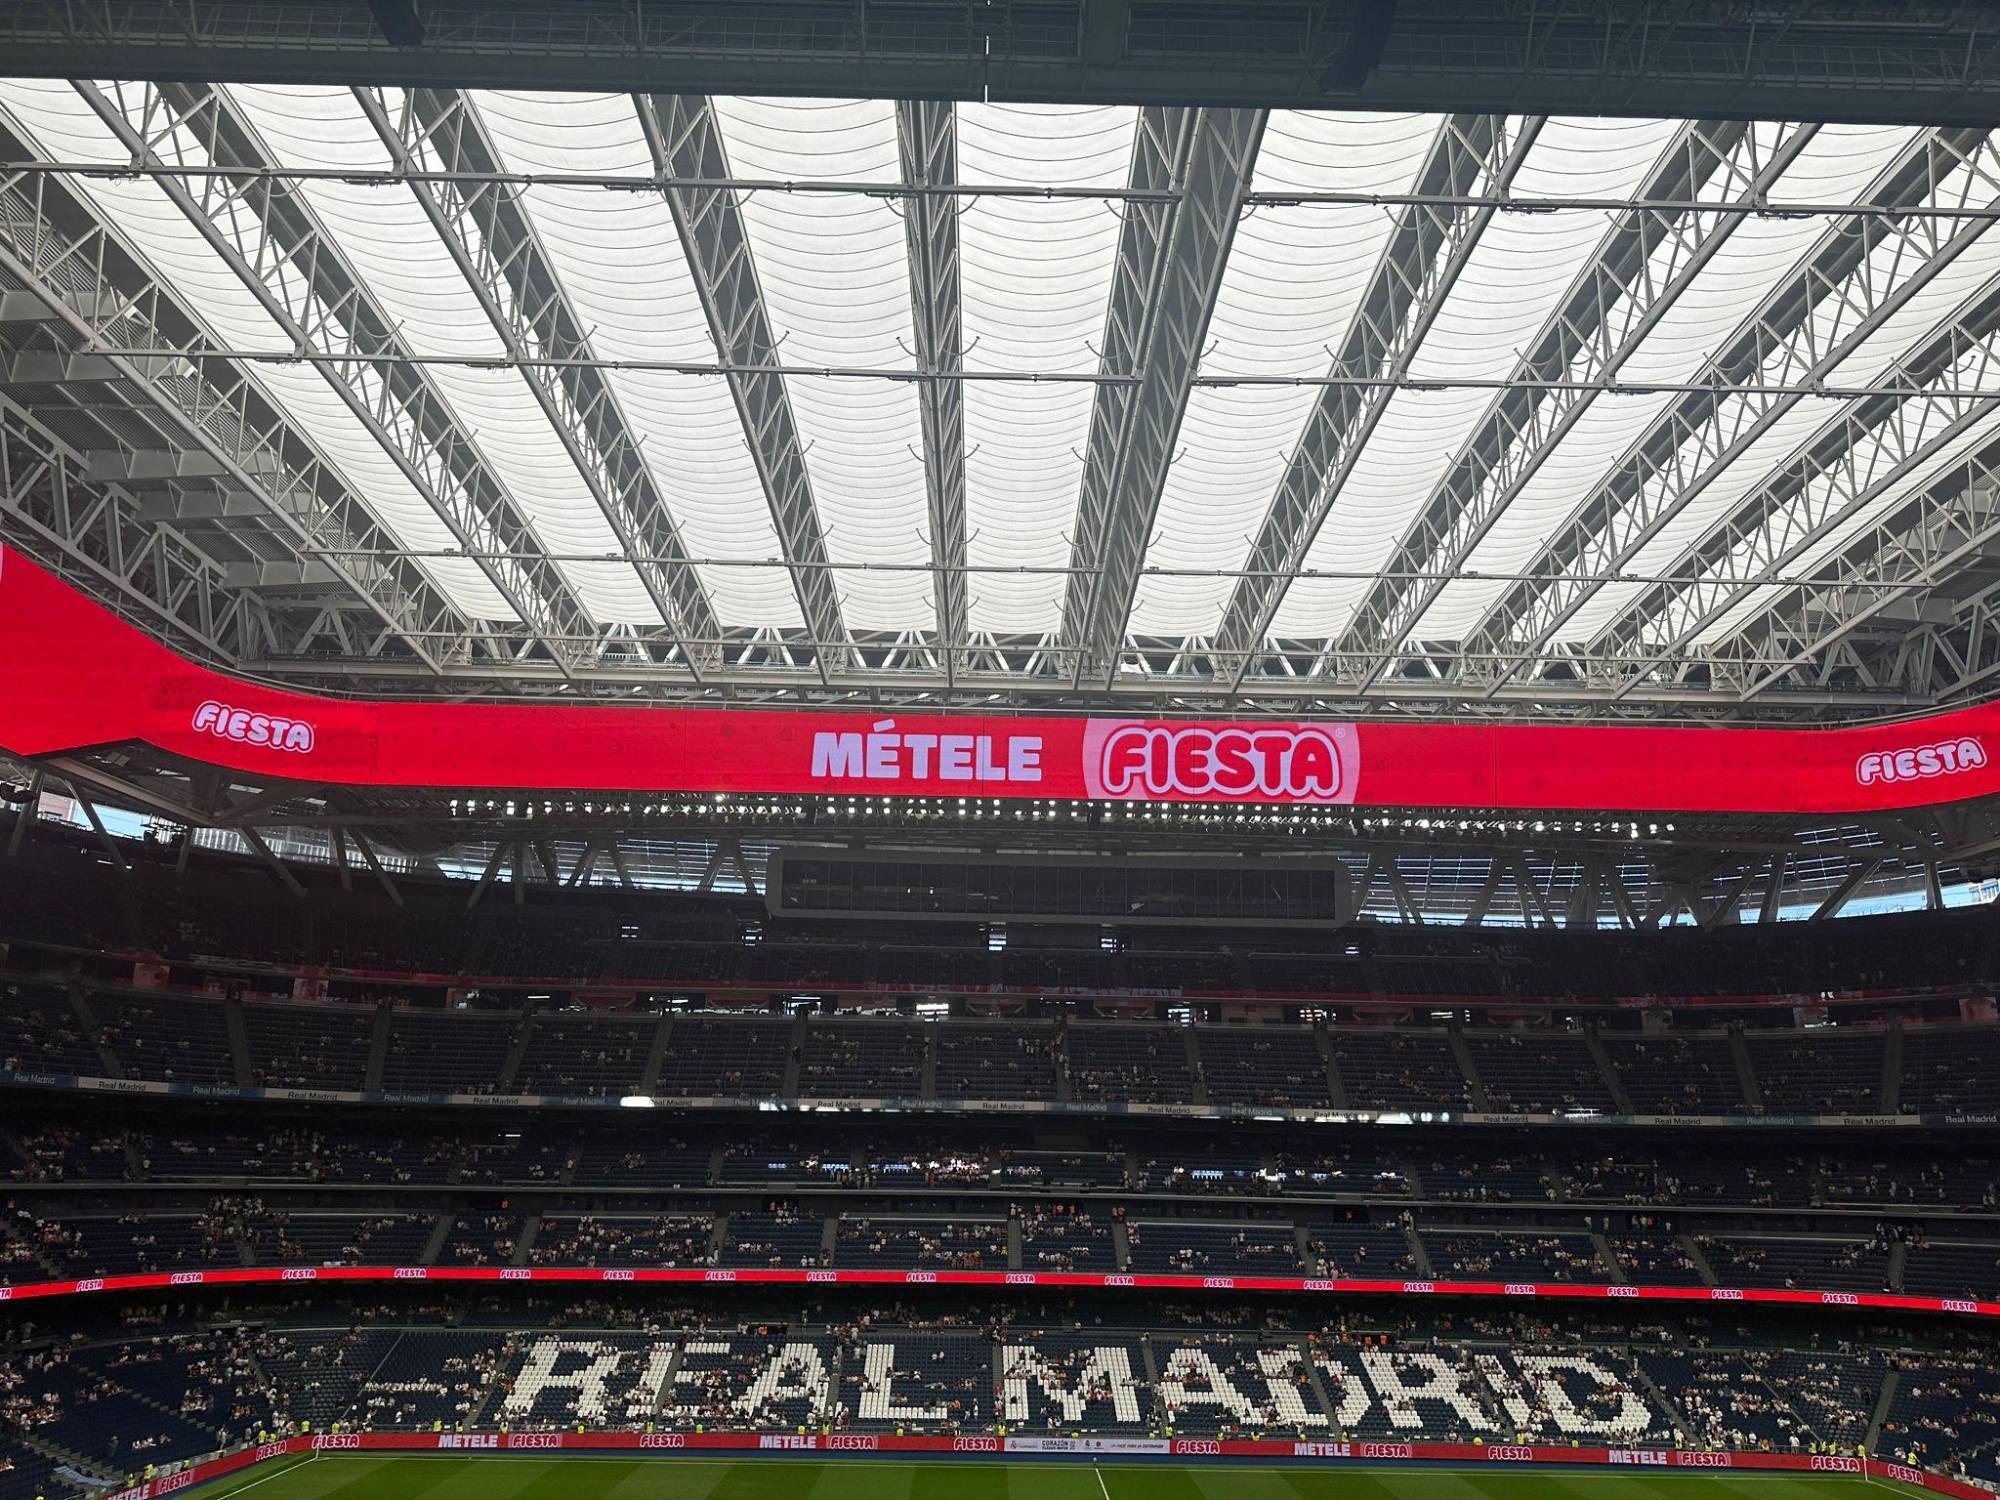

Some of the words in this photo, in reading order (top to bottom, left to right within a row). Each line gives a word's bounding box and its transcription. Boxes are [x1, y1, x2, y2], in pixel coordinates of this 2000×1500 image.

[193, 701, 314, 753] FIESTA
[811, 719, 1042, 781] MÉTELE
[1103, 727, 1341, 797] FIESTA
[1857, 738, 1987, 785] FIESTA
[14, 1073, 30, 1082] Real
[30, 1074, 55, 1084] Madrid
[99, 1081, 116, 1089] Real
[118, 1082, 146, 1091] Madrid
[193, 1086, 210, 1095] Real
[212, 1087, 240, 1095] Madrid
[384, 1094, 401, 1102] Real
[403, 1095, 429, 1103] Madrid
[1866, 1118, 1896, 1126] Madrid
[1945, 1115, 1965, 1124] Real
[1967, 1115, 1997, 1124] Madrid
[171, 1272, 203, 1284] FIESTA
[282, 1269, 316, 1280] FIESTA
[394, 1268, 427, 1279] FIESTA
[499, 1269, 531, 1279] FIESTA
[603, 1270, 634, 1280] FIESTA
[705, 1271, 736, 1281] FIESTA
[806, 1272, 836, 1281] FIESTA
[906, 1273, 936, 1282] FIESTA
[1006, 1274, 1035, 1284] FIESTA
[76, 1279, 103, 1292] FIESTA
[1104, 1276, 1134, 1286] FIESTA
[1203, 1278, 1234, 1288] FIESTA
[1303, 1280, 1334, 1290] FIESTA
[1404, 1282, 1434, 1293] FIESTA
[1505, 1284, 1536, 1295] FIESTA
[1607, 1287, 1639, 1297] FIESTA
[1712, 1289, 1743, 1300] FIESTA
[1823, 1294, 1858, 1304] FIESTA
[1942, 1301, 1977, 1312] FIESTA
[502, 1341, 949, 1419] REAL
[312, 1435, 360, 1449] FIESTA
[512, 1434, 559, 1448] FIESTA
[640, 1434, 684, 1448] FIESTA
[829, 1436, 875, 1449] FIESTA
[953, 1438, 997, 1451] FIESTA
[255, 1440, 287, 1461] FIESTA
[1176, 1441, 1220, 1454] FIESTA
[1364, 1443, 1409, 1457] FIESTA
[1488, 1446, 1532, 1460] FIESTA
[1681, 1452, 1728, 1466] FIESTA
[1811, 1456, 1860, 1472] FIESTA
[1888, 1464, 1924, 1486] FIESTA
[157, 1471, 193, 1495] FIESTA
